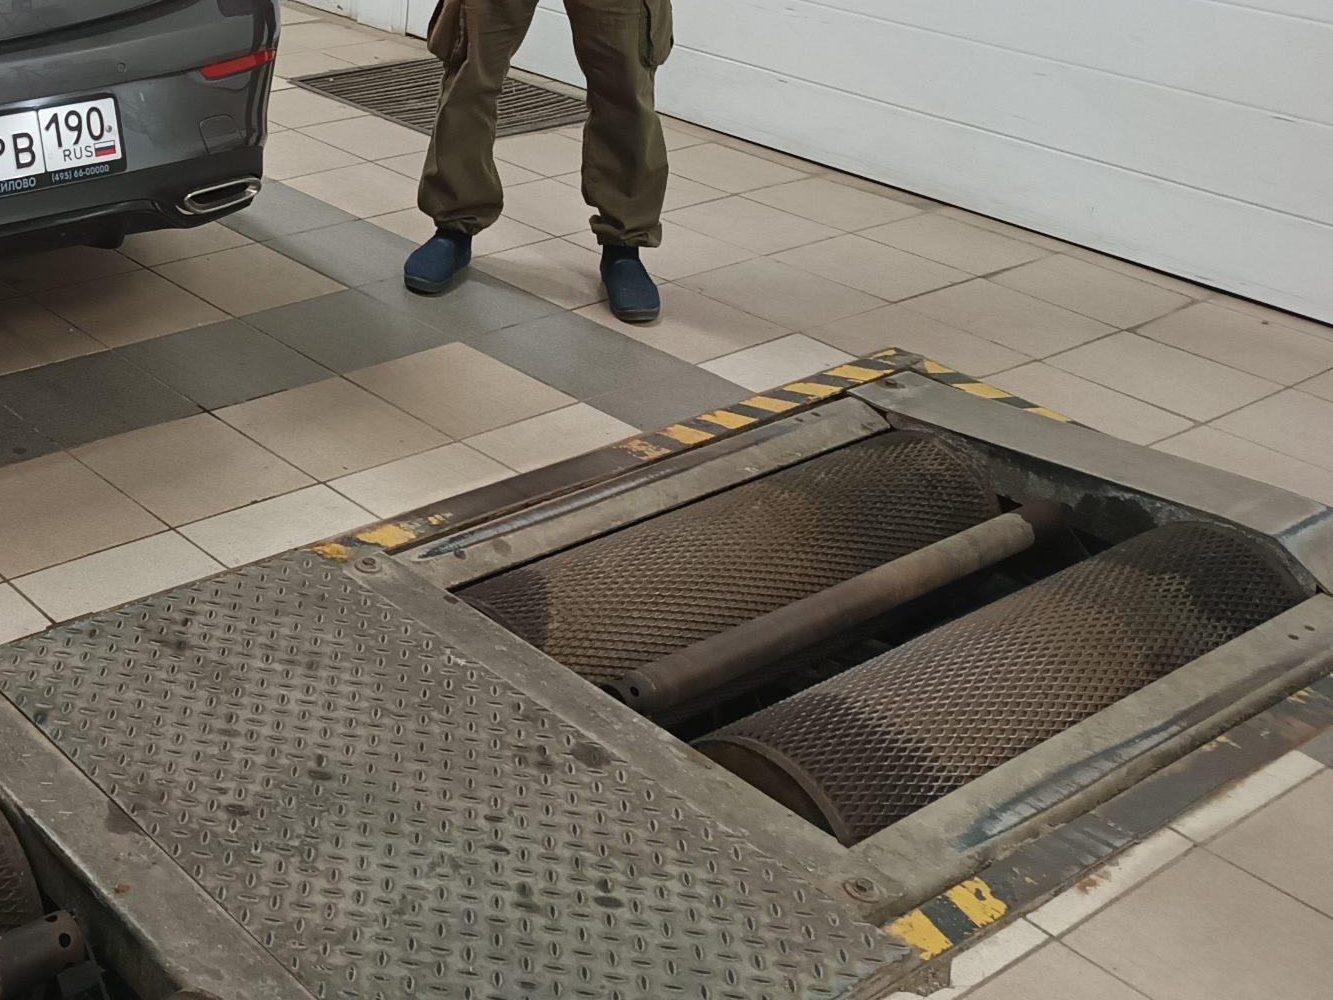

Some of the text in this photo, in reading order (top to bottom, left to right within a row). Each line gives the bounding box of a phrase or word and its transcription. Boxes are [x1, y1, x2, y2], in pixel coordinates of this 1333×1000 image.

[44, 106, 104, 148] 190
[63, 145, 93, 162] RUS
[51, 172, 72, 183] (495)
[73, 164, 110, 178] 66-00000
